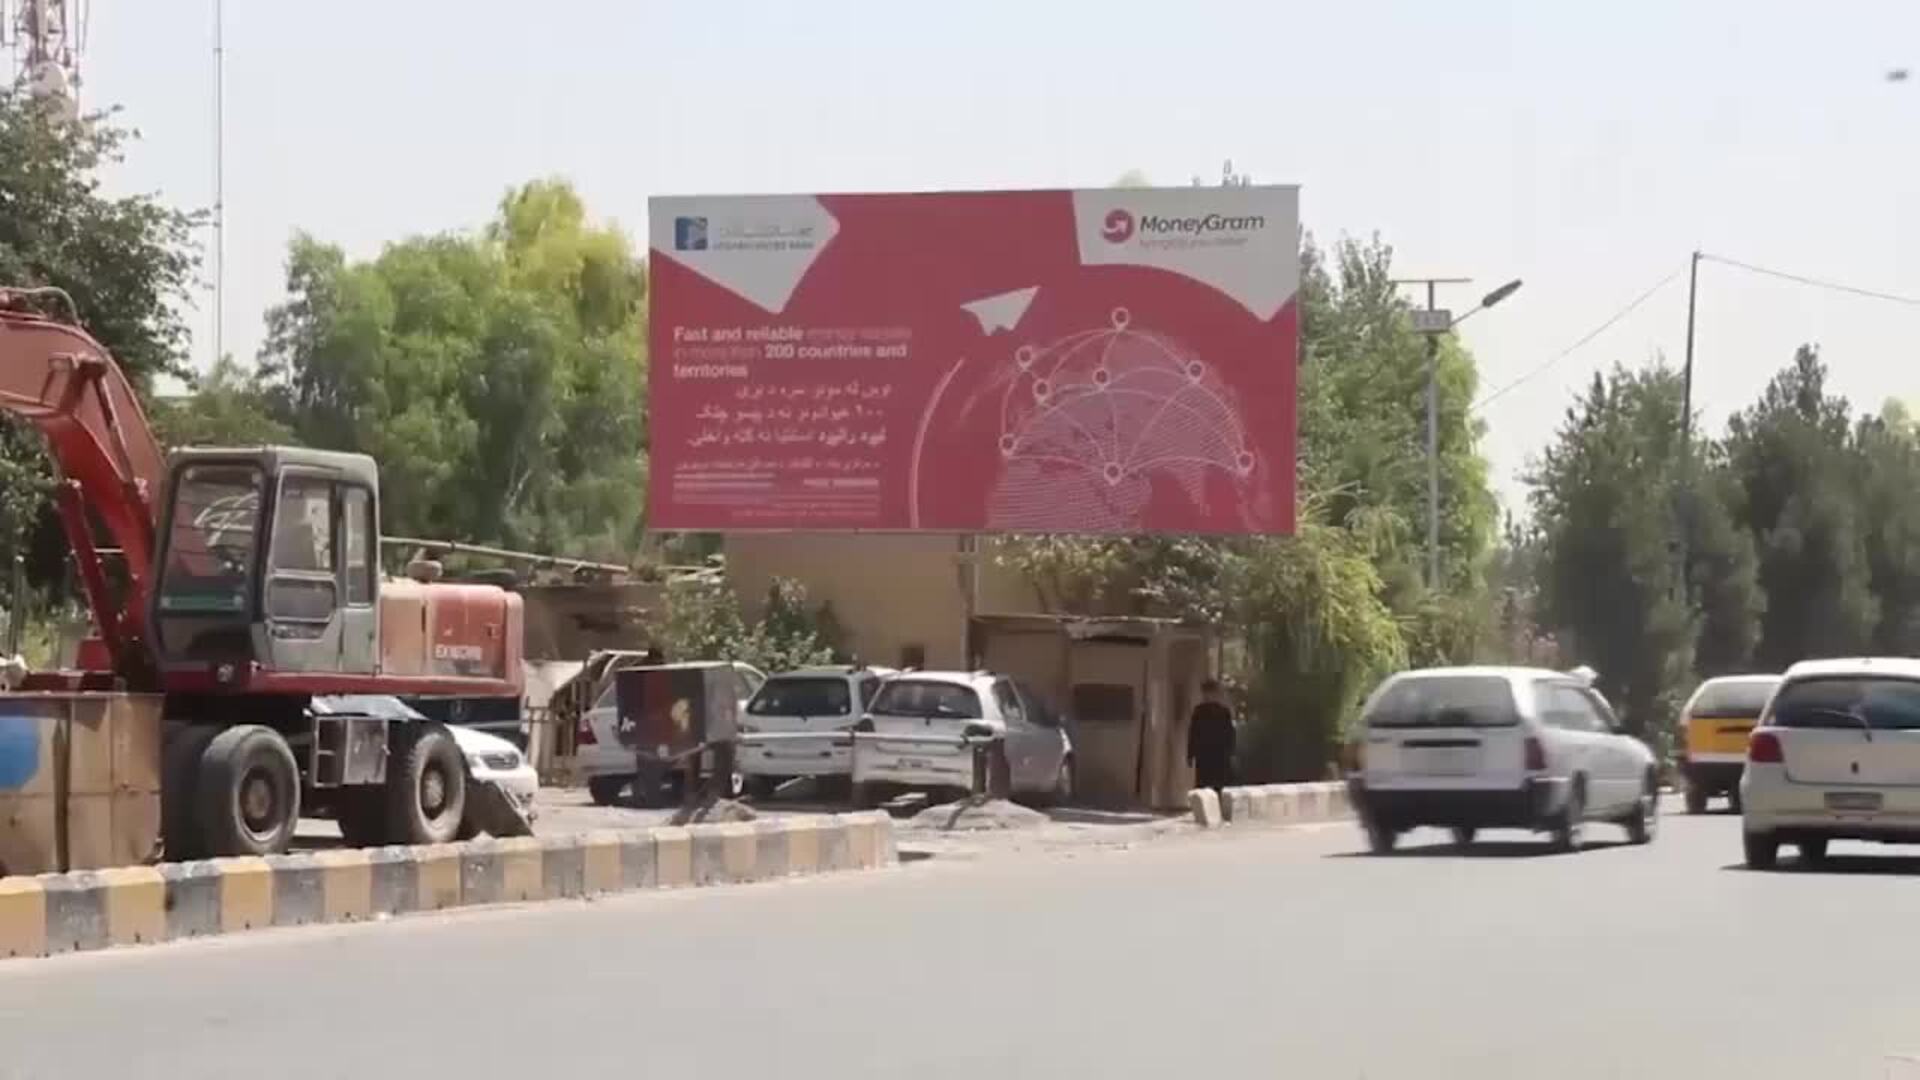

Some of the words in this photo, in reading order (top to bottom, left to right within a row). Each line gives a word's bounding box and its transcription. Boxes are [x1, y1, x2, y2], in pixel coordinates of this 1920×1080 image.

[1139, 213, 1265, 235] MoneyGram
[673, 326, 708, 342] Fast
[711, 326, 742, 342] and
[745, 325, 804, 342] reliable
[764, 343, 794, 359] 200
[797, 343, 872, 359] countries
[875, 343, 908, 358] and
[673, 362, 748, 379] territories
